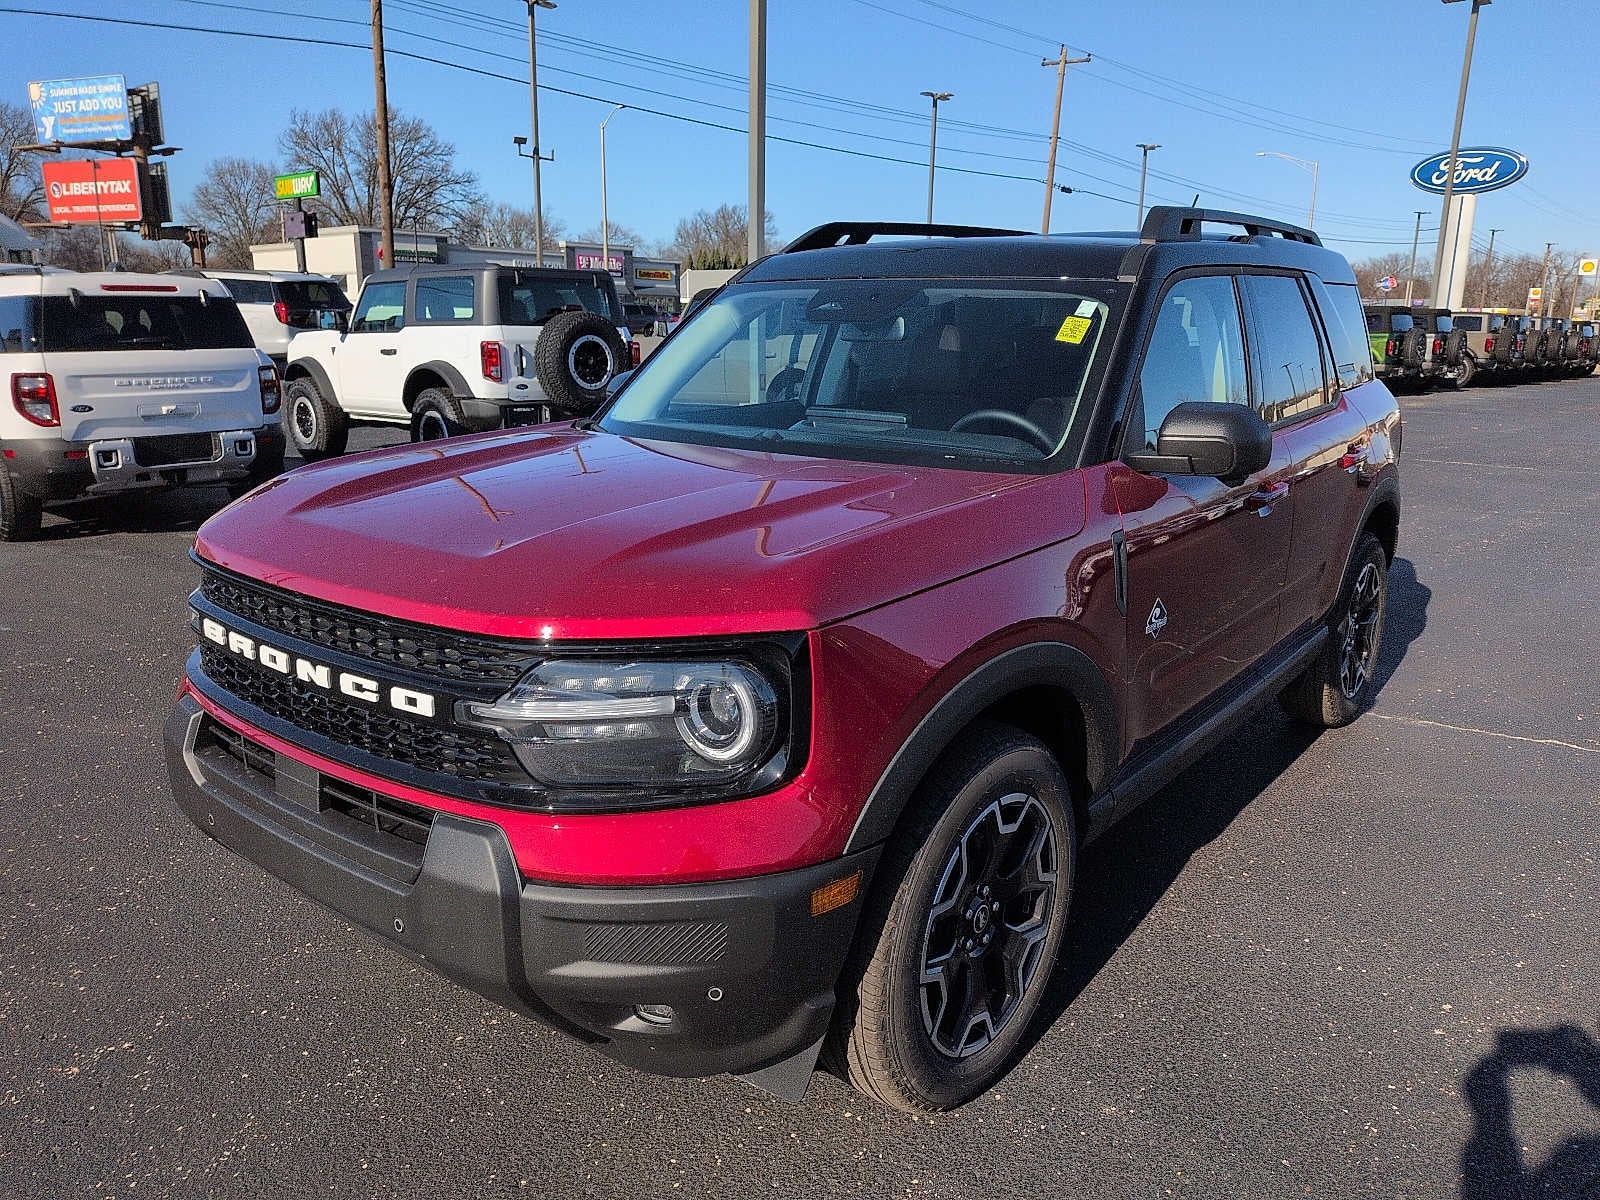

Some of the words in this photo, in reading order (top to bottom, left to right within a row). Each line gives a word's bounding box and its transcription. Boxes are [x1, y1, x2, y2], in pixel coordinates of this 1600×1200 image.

[49, 87, 78, 97] SUMMER
[79, 85, 97, 95] MADE
[97, 83, 122, 93] SIMPLE
[54, 100, 77, 113] JUST
[79, 98, 99, 111] ADD
[101, 97, 122, 109] YOU
[1431, 157, 1501, 185] Ford
[277, 175, 315, 195] SUBWAY
[203, 617, 435, 718] BRONCO
